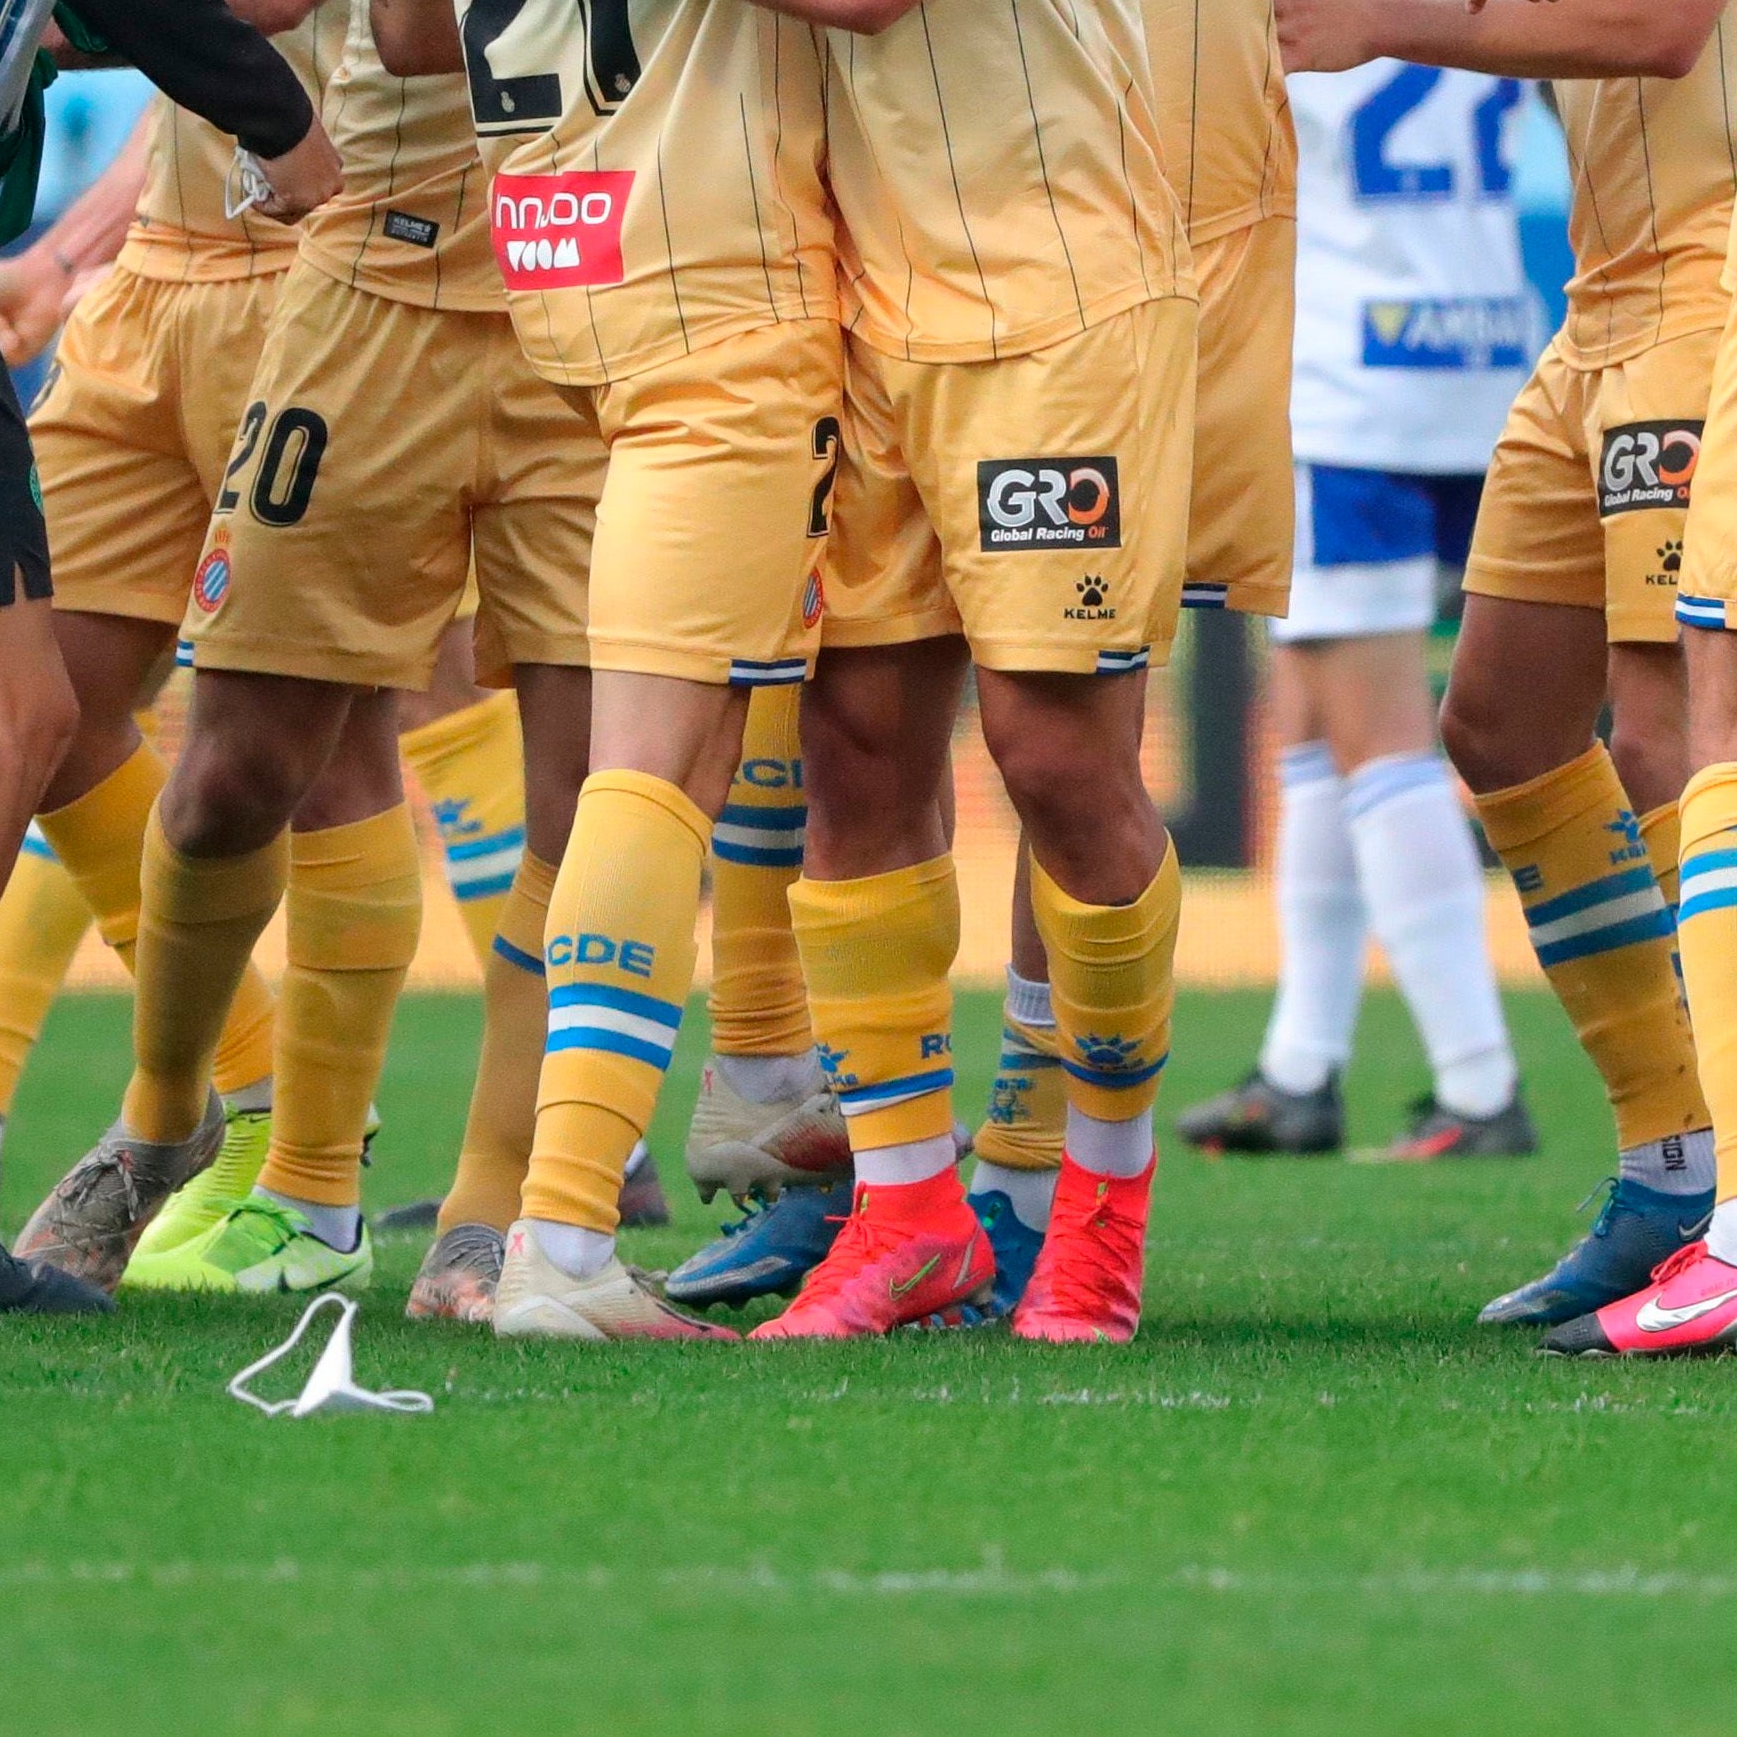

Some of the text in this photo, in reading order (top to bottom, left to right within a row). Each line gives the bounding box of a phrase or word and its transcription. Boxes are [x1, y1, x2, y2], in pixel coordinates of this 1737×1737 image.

[213, 400, 328, 528] 20
[986, 467, 1110, 527] GRO
[1604, 490, 1630, 507] Global
[1630, 486, 1674, 503] Racing
[990, 527, 1033, 543] Global
[1035, 526, 1085, 541] Racing
[1063, 608, 1117, 620] KELME
